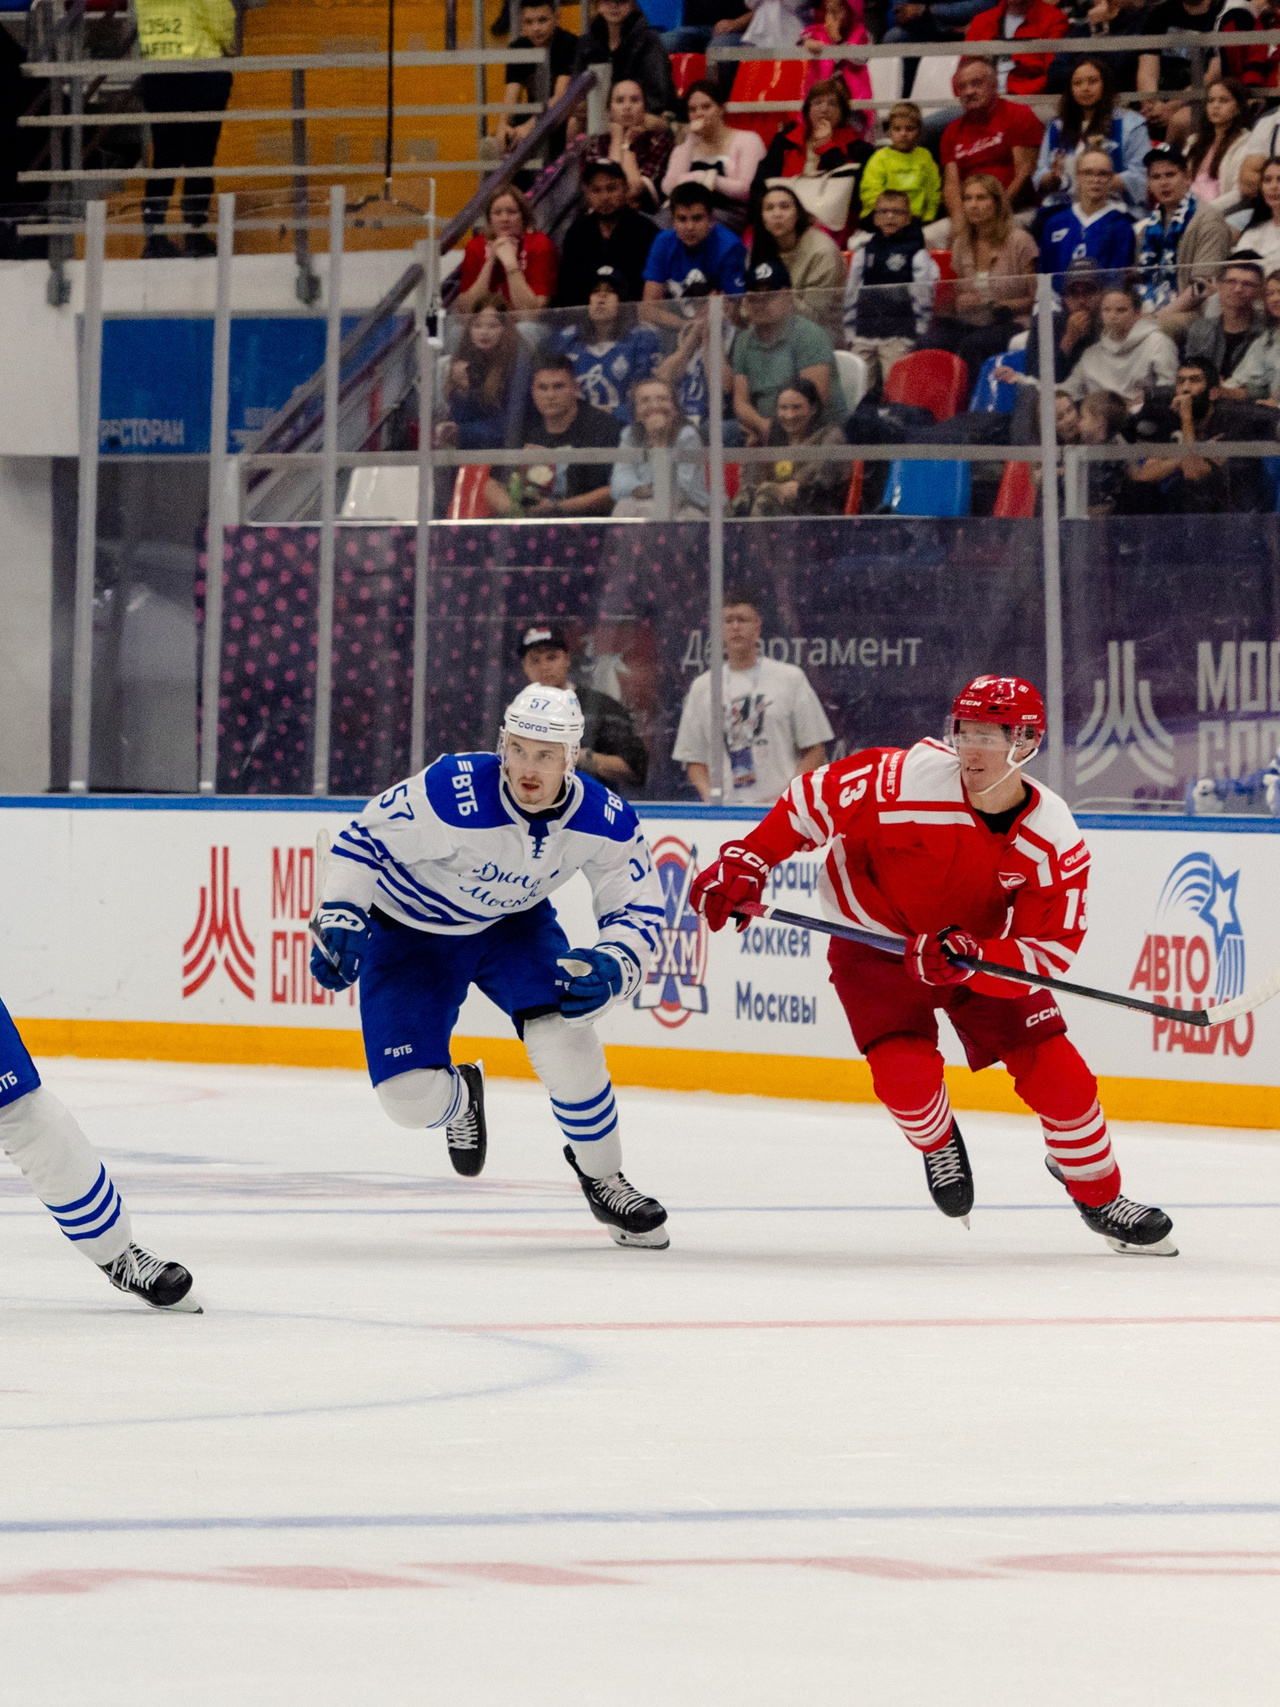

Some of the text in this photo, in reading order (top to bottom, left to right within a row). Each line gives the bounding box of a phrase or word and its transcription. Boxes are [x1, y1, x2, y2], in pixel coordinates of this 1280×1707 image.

[530, 698, 551, 711] 57
[379, 784, 415, 821] 57
[451, 773, 479, 816] ВТБ
[839, 763, 874, 809] 13
[740, 925, 812, 958] хоккея
[1129, 934, 1210, 994] АВТО
[734, 980, 818, 1026] Москвы
[1025, 1006, 1061, 1029] CCM
[392, 1043, 413, 1058] ВТБ
